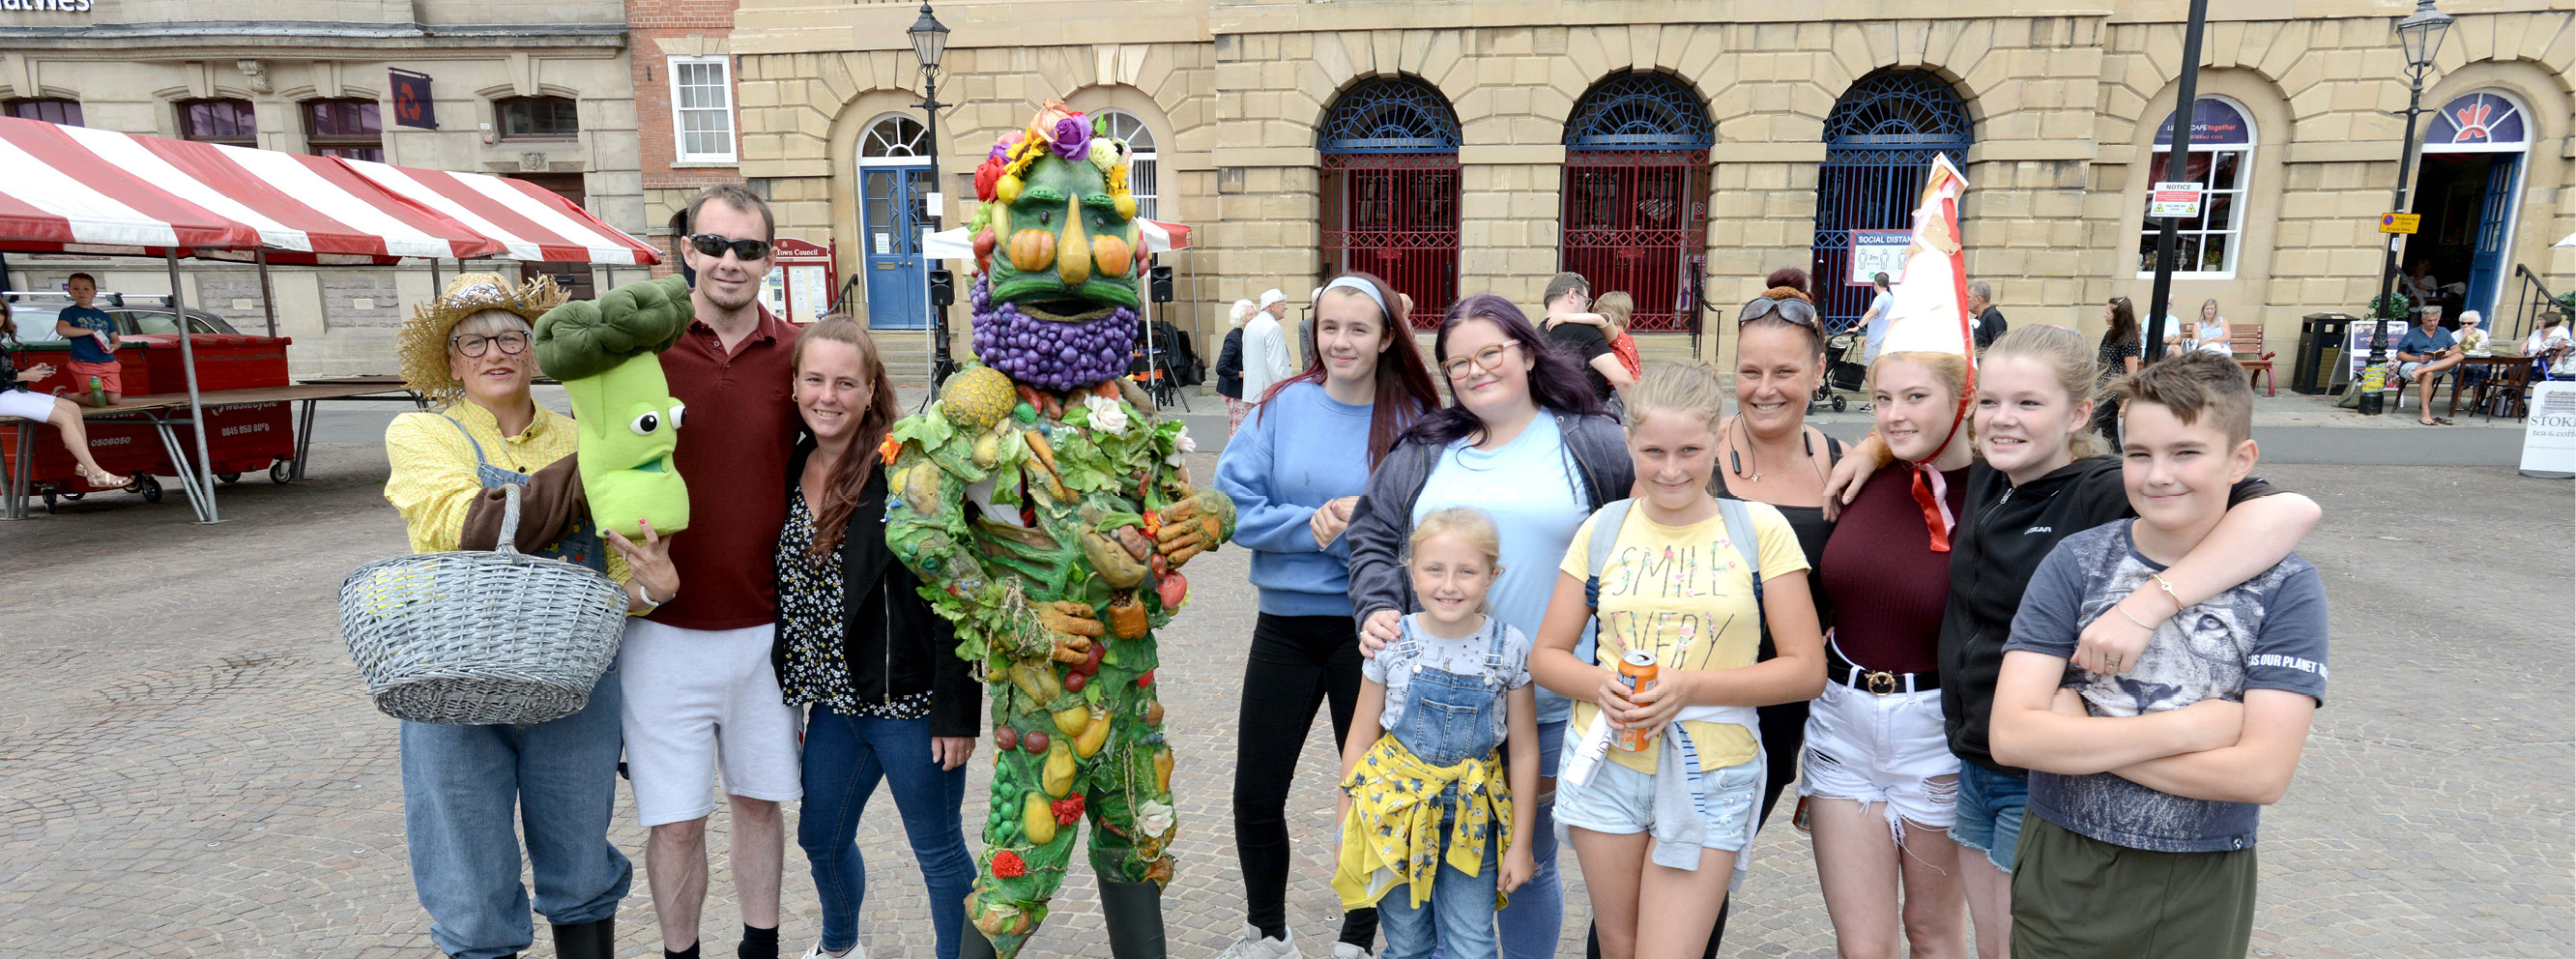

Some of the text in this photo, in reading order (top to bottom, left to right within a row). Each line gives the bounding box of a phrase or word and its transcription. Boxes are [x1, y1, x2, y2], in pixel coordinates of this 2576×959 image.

[2208, 123, 2237, 132] together
[2530, 416, 2575, 427] STOK
[221, 425, 239, 437] 0845
[239, 424, 252, 434] 050
[91, 436, 131, 447] 0508050
[1612, 541, 1734, 597] SMILE
[2260, 654, 2282, 667] OUR
[2282, 655, 2318, 674] PLANET
